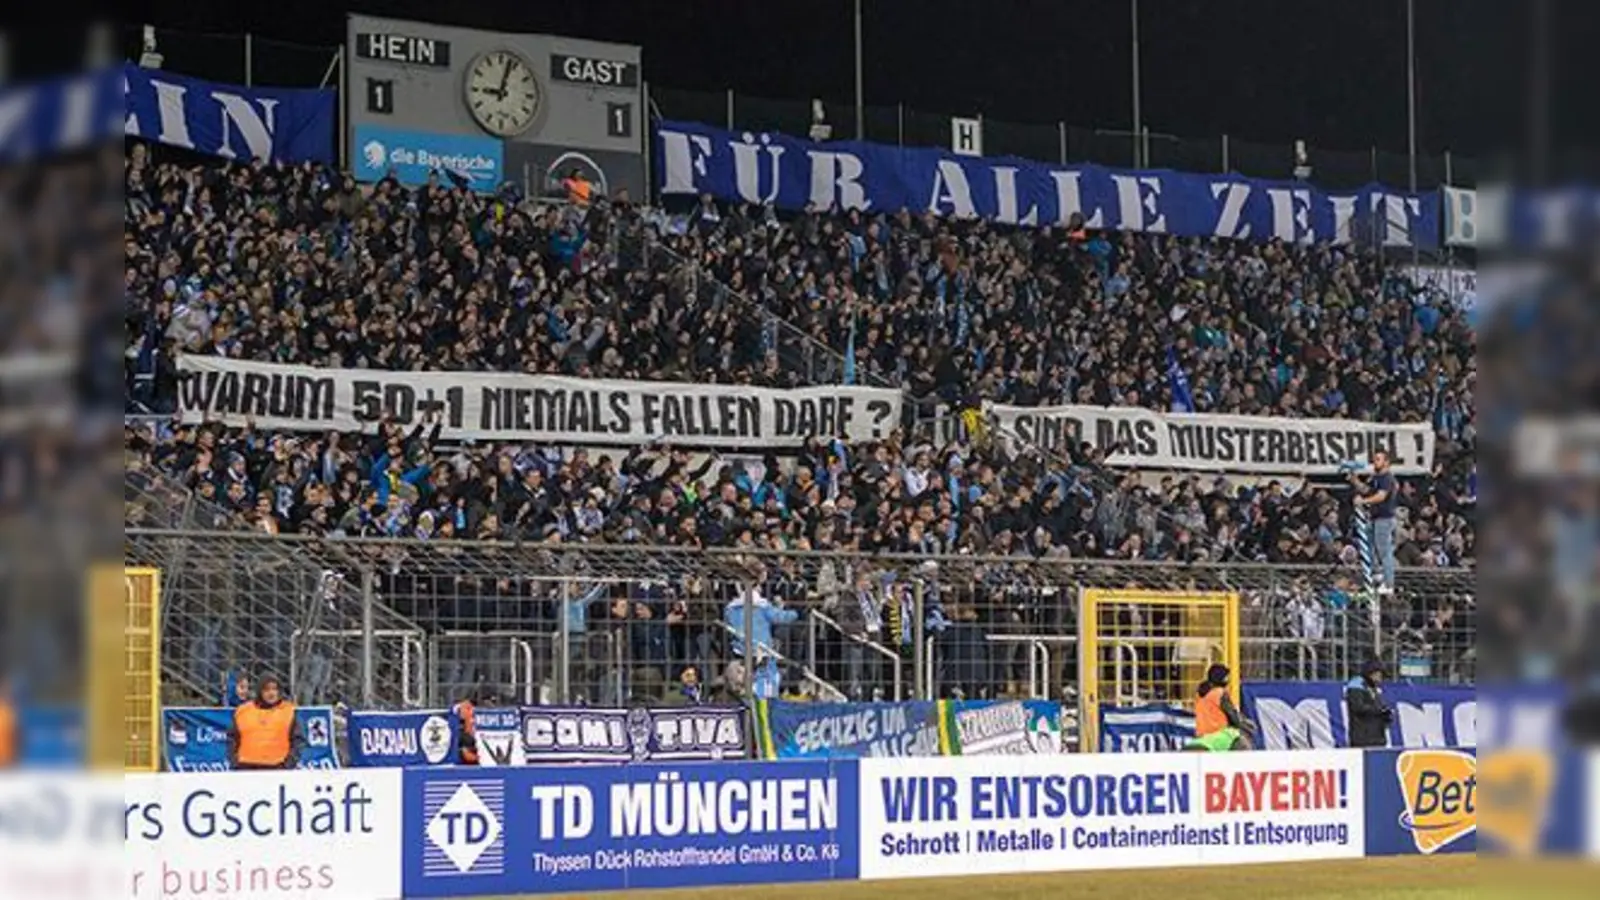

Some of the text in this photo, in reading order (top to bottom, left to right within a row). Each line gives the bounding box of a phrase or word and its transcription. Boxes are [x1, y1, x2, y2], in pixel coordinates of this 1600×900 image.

[563, 57, 627, 84] GAST
[374, 84, 384, 109] 1
[614, 107, 624, 133] 1
[958, 118, 974, 152] H
[390, 148, 415, 165] die
[658, 131, 1420, 247] FÜR ALLE ZEIT
[177, 370, 336, 420] WARUM
[352, 380, 464, 428] 50+1
[480, 386, 631, 434] NIEMALS
[641, 393, 761, 437] FALLEN
[773, 396, 854, 440] DARF
[866, 400, 892, 438] ?
[1096, 419, 1159, 457] DAS
[1167, 422, 1405, 467] MUSTERBEISPIEL
[1412, 433, 1425, 466] !
[361, 728, 418, 756] DACHAU
[526, 717, 740, 747] COMI TIVA
[182, 781, 373, 839] Gschäft
[532, 772, 838, 840] TD MÜNCHEN
[880, 769, 1348, 823] WIR ENTSORGEN BAYERN!
[1414, 770, 1476, 816] Bet
[439, 811, 489, 845] TD
[881, 820, 1349, 857] Schrott Metalle Containerdienst Entsorgung
[532, 851, 592, 875] Thyssen
[595, 849, 632, 870] Dück
[634, 842, 737, 868] Rohstoffhandel
[739, 843, 779, 864] GmbH
[780, 844, 794, 862] &
[796, 843, 818, 863] Co.
[162, 860, 335, 896] business
